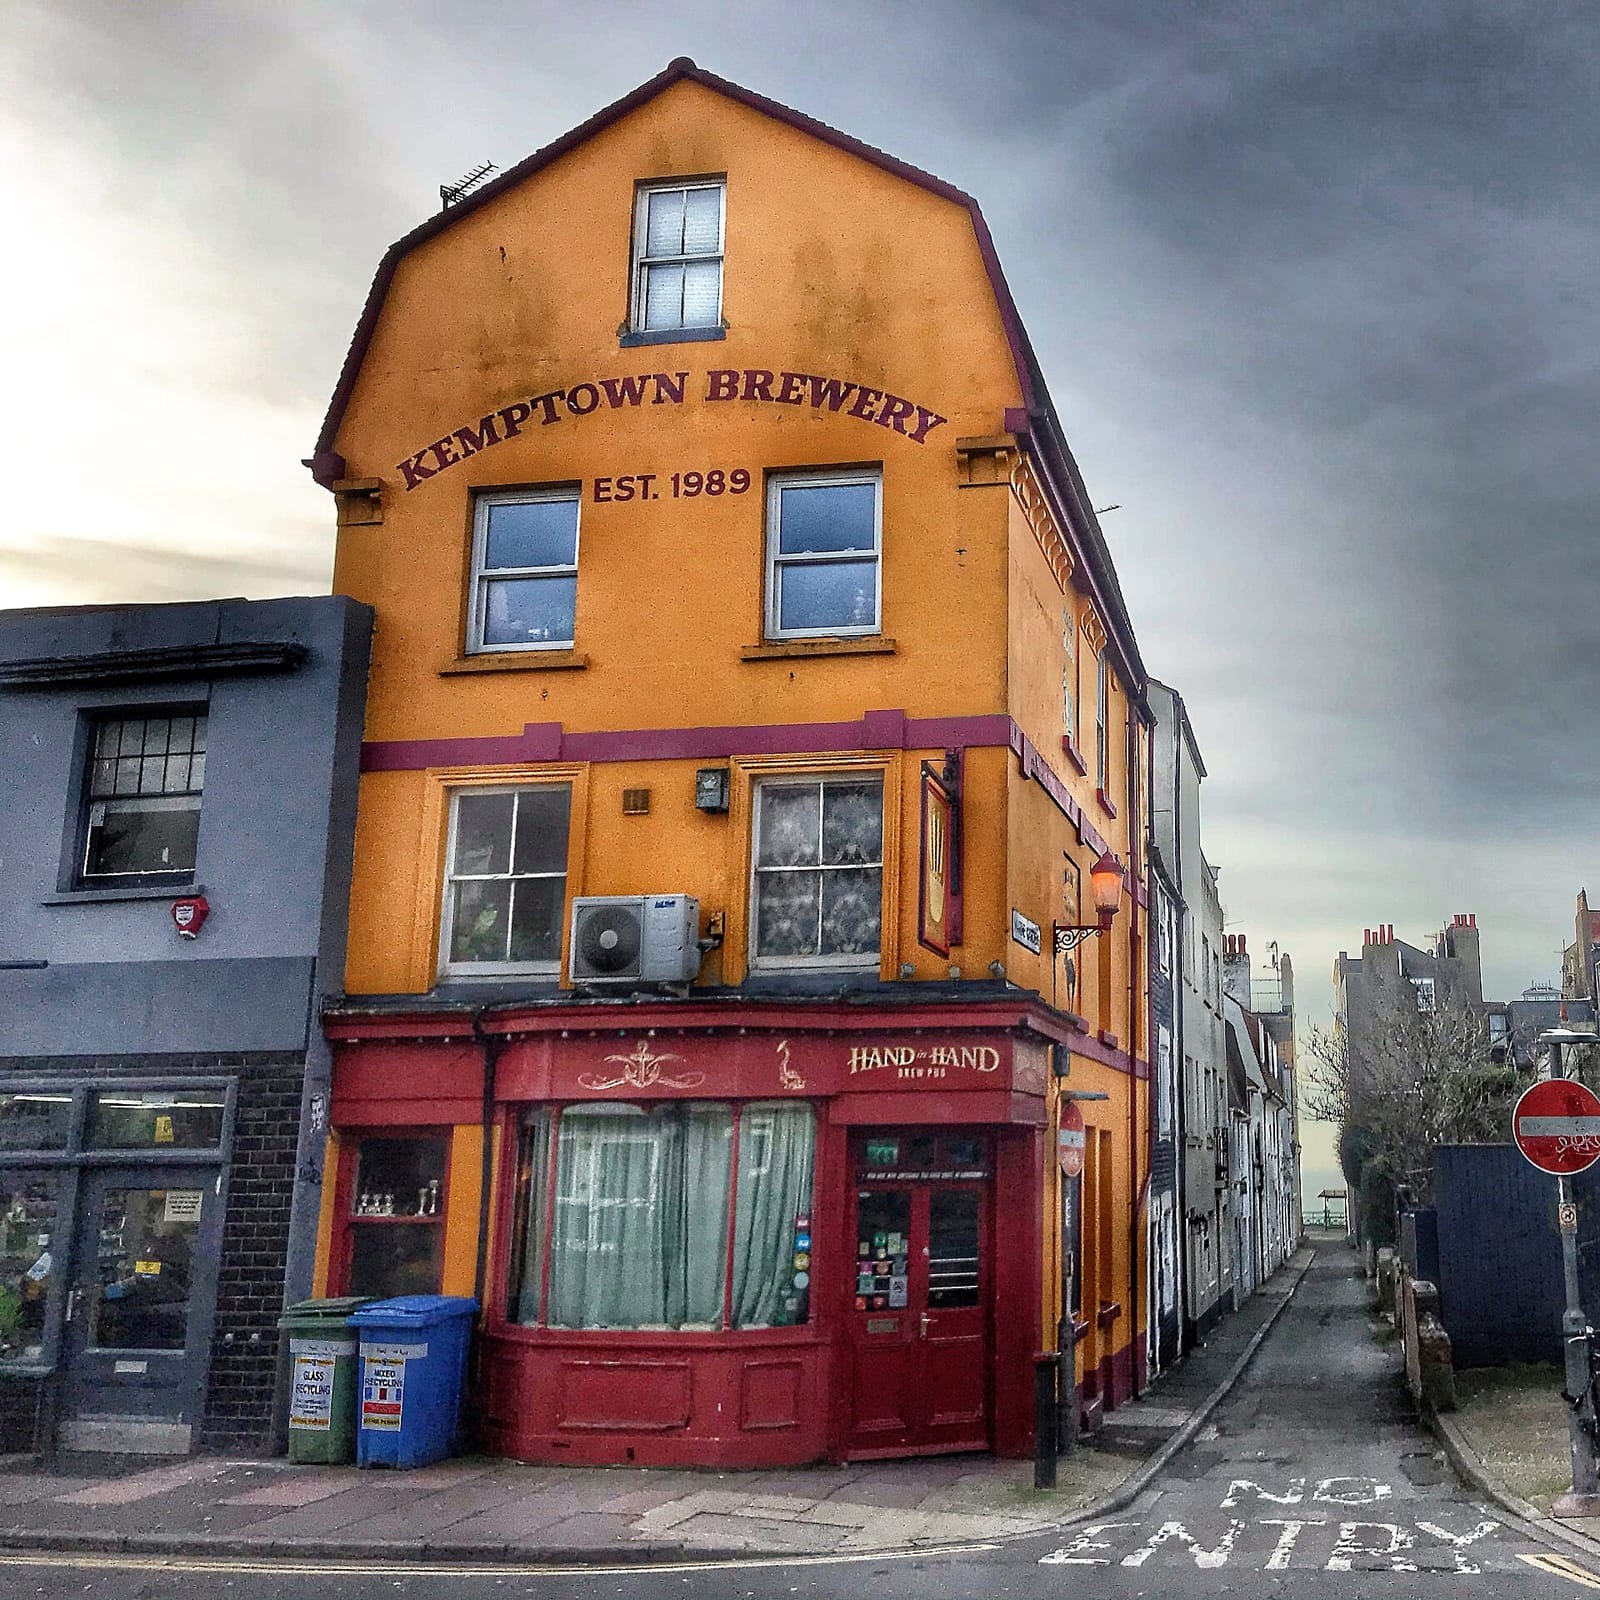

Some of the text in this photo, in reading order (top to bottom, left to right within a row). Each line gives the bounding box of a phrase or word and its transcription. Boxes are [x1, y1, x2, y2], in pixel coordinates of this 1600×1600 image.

[396, 369, 946, 491] KEMPTOWN BREWERY
[593, 468, 751, 503] EST. 1989
[847, 1047, 914, 1075] HAND
[929, 1047, 1000, 1072] HAND
[303, 1370, 324, 1382] GLASS
[374, 1369, 396, 1378] MIXED
[295, 1383, 331, 1395] RECYCLING
[1219, 1477, 1392, 1508] NO
[1038, 1520, 1501, 1574] ENTRY
